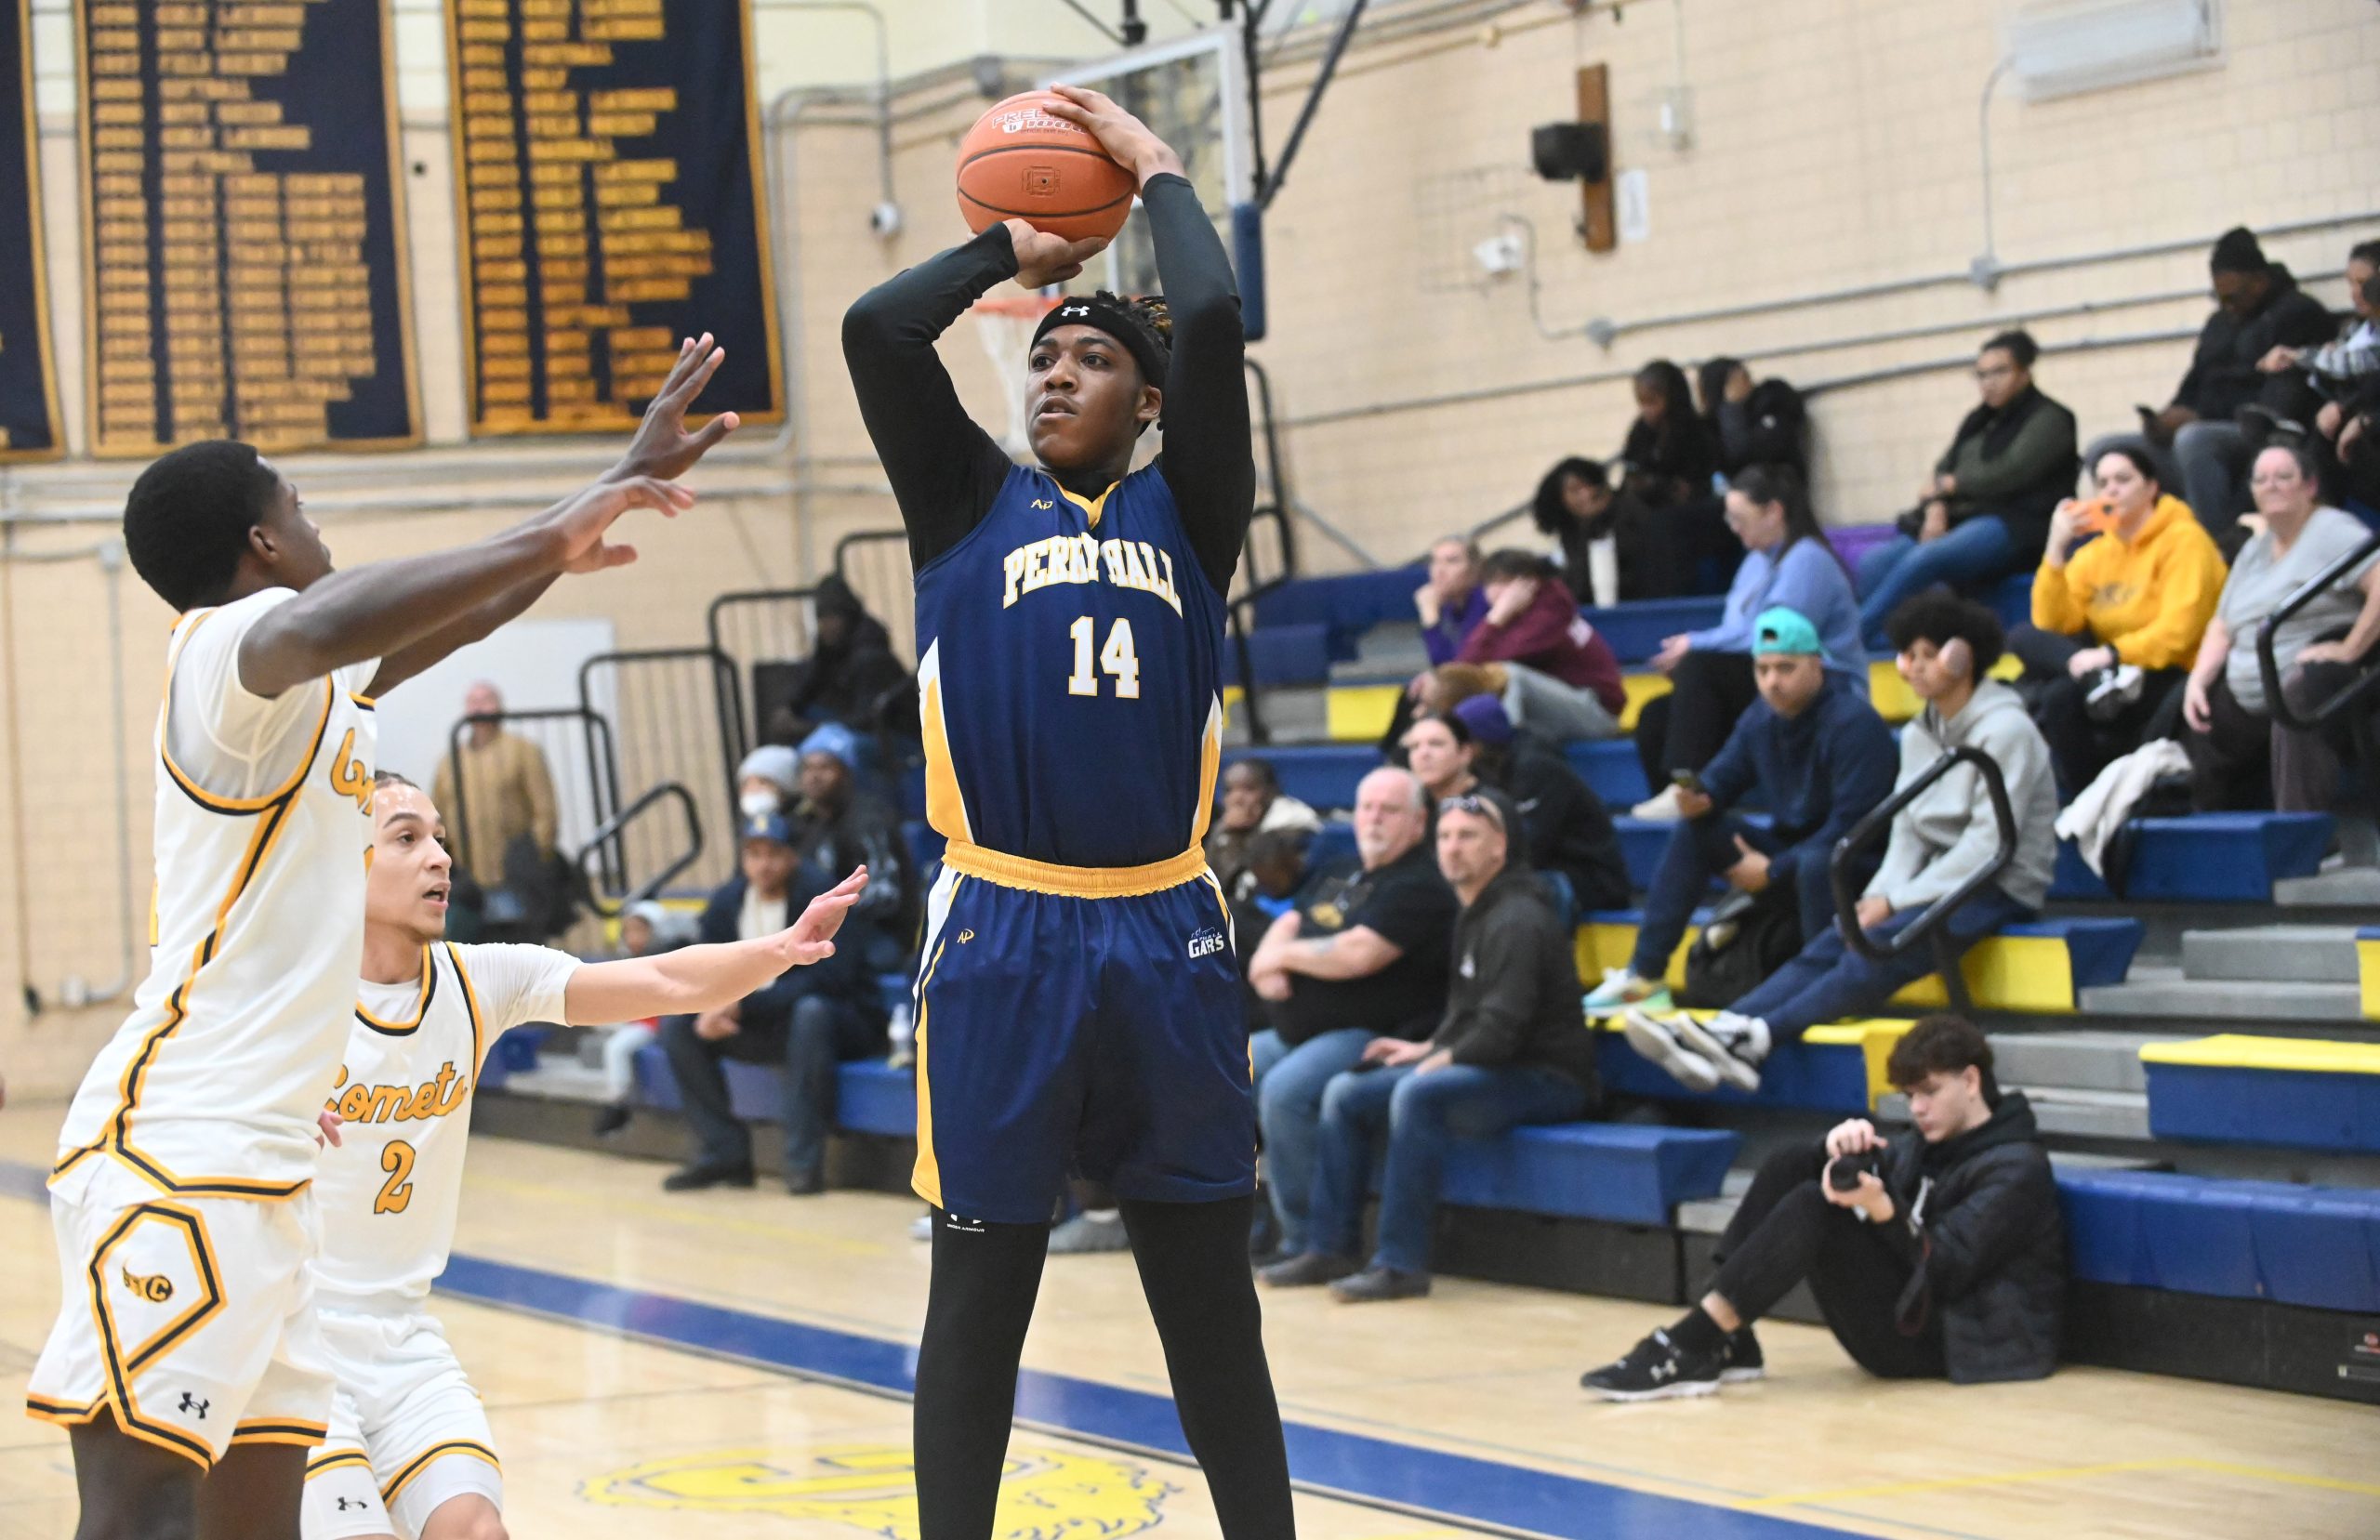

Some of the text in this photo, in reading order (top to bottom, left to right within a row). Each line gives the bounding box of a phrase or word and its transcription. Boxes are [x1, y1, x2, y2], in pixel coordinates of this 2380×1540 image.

[992, 109, 1056, 128] PREC
[1002, 532, 1183, 620] PERRY HALL
[1069, 615, 1140, 699] 14
[324, 1060, 468, 1124] omets
[374, 1139, 416, 1215] 2
